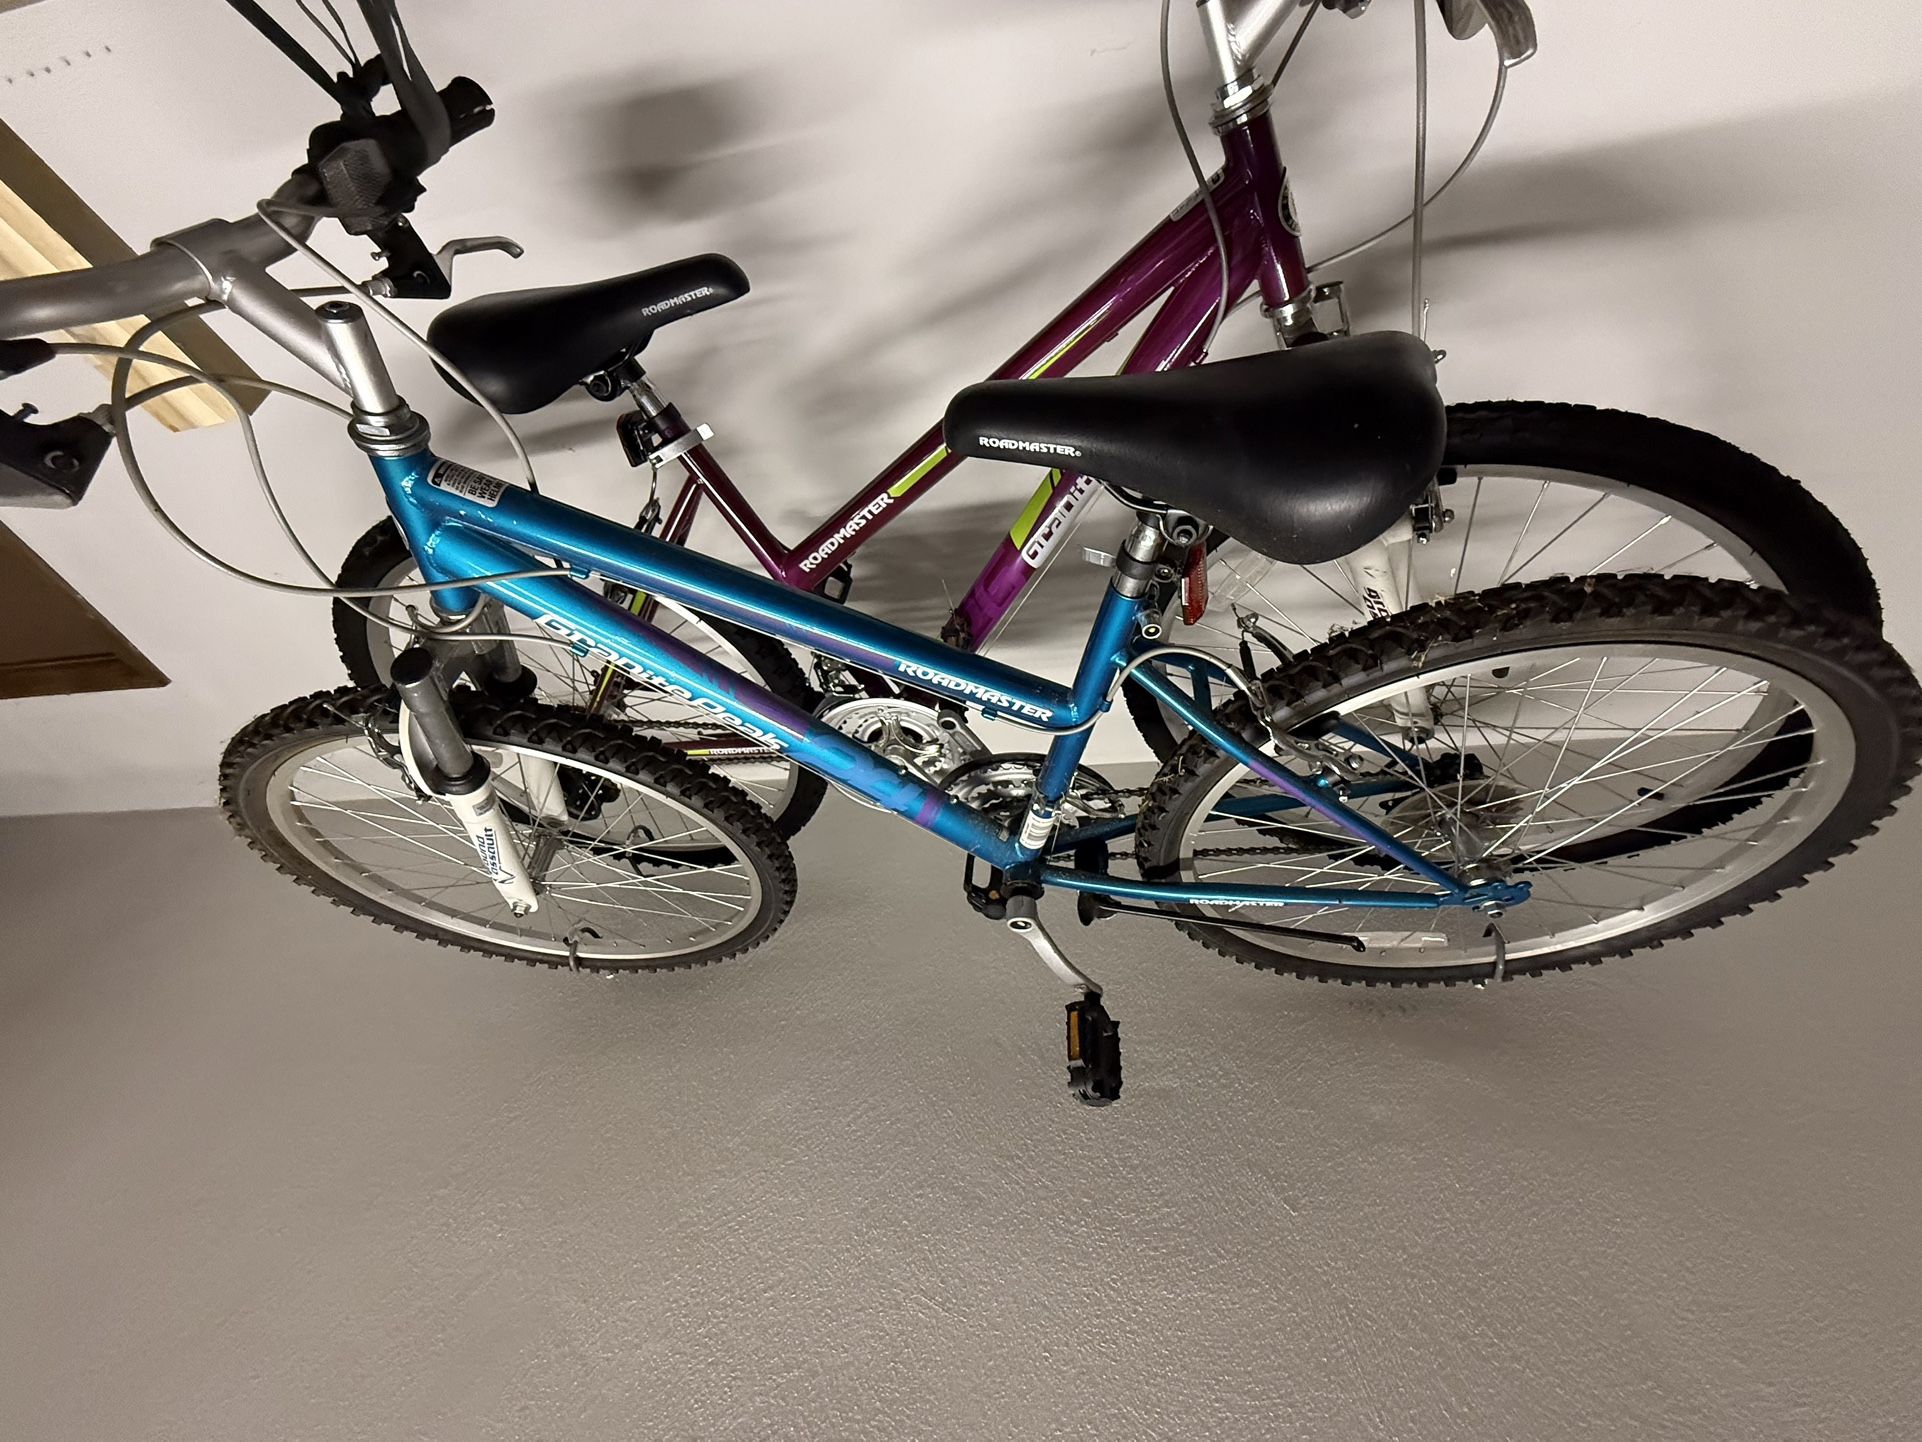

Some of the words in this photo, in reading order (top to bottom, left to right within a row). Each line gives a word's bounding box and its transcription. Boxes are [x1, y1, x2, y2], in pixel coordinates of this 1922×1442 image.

[799, 492, 894, 573] ROADMASTER
[1024, 473, 1097, 564] Granit
[535, 613, 693, 700] Granite
[897, 659, 1053, 722] ROADMASTER
